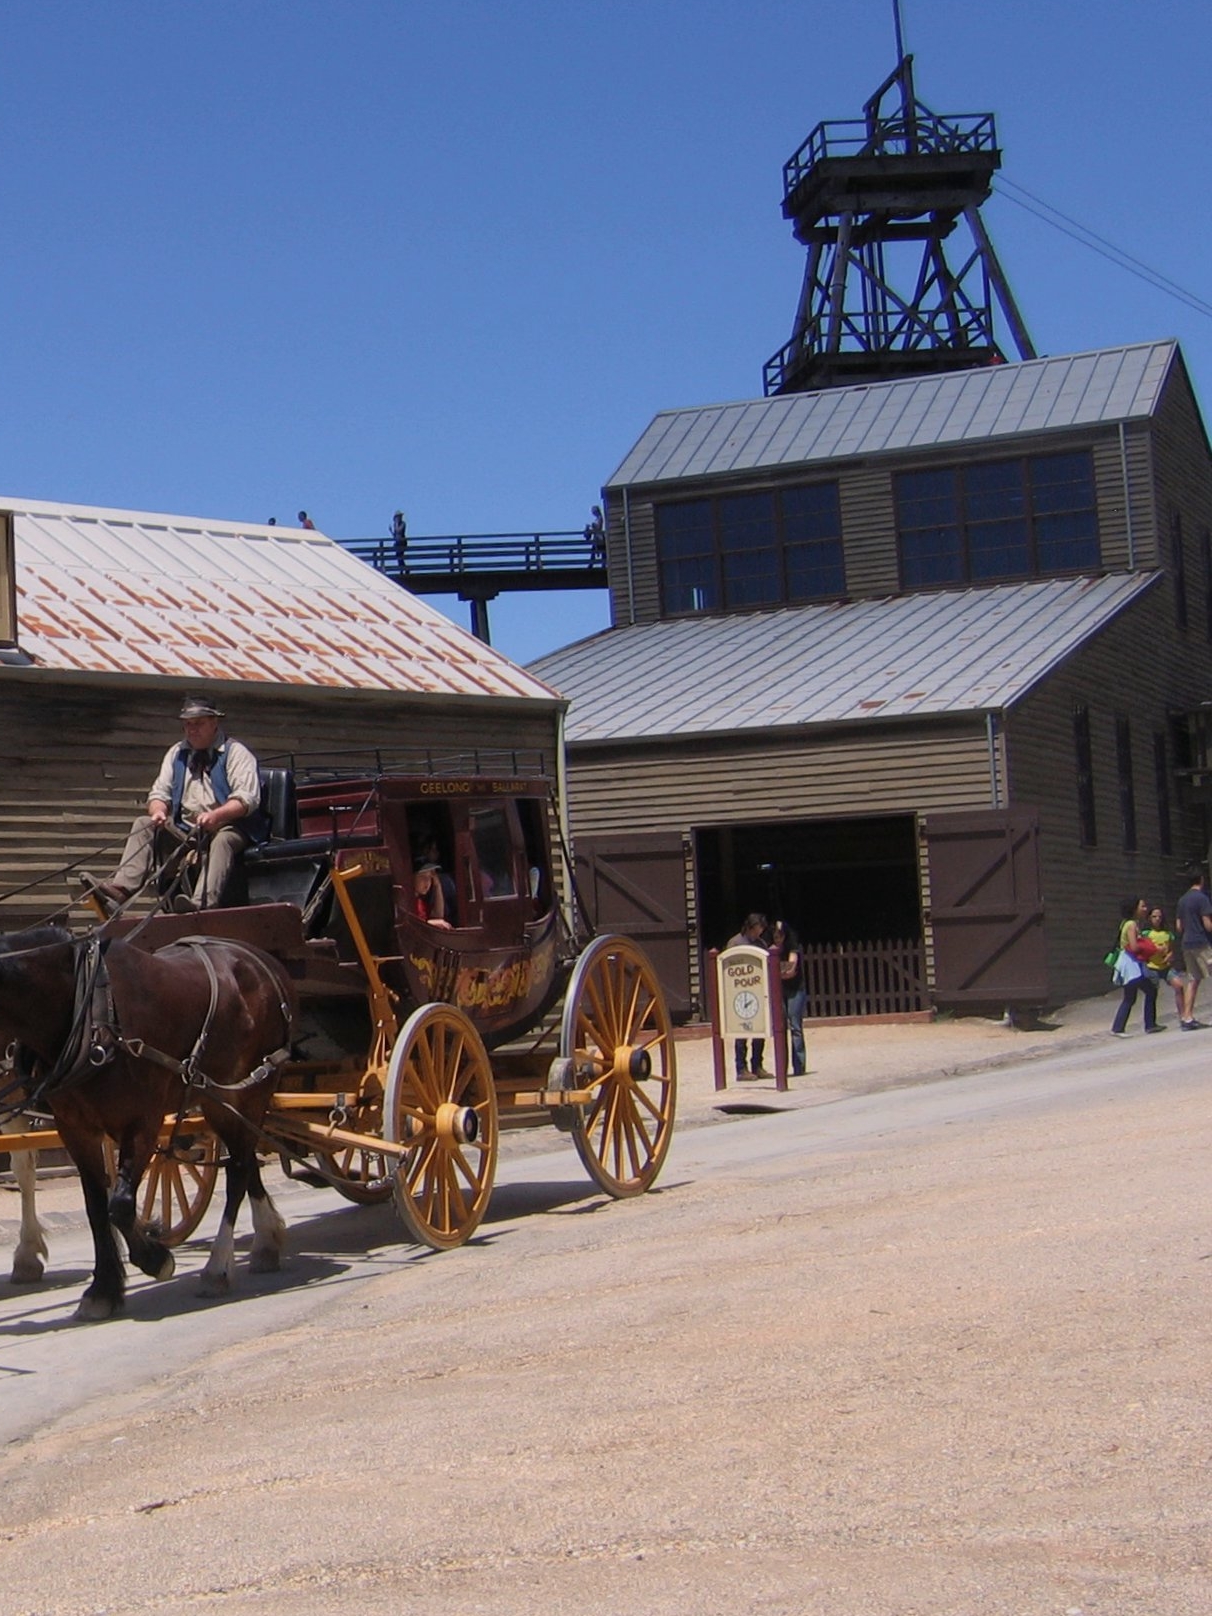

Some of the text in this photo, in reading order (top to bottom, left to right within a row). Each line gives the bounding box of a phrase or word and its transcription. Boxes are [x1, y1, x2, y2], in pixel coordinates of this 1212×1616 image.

[419, 782, 470, 794] GEELONG
[728, 964, 754, 977] GOLD
[734, 975, 762, 988] POUR
